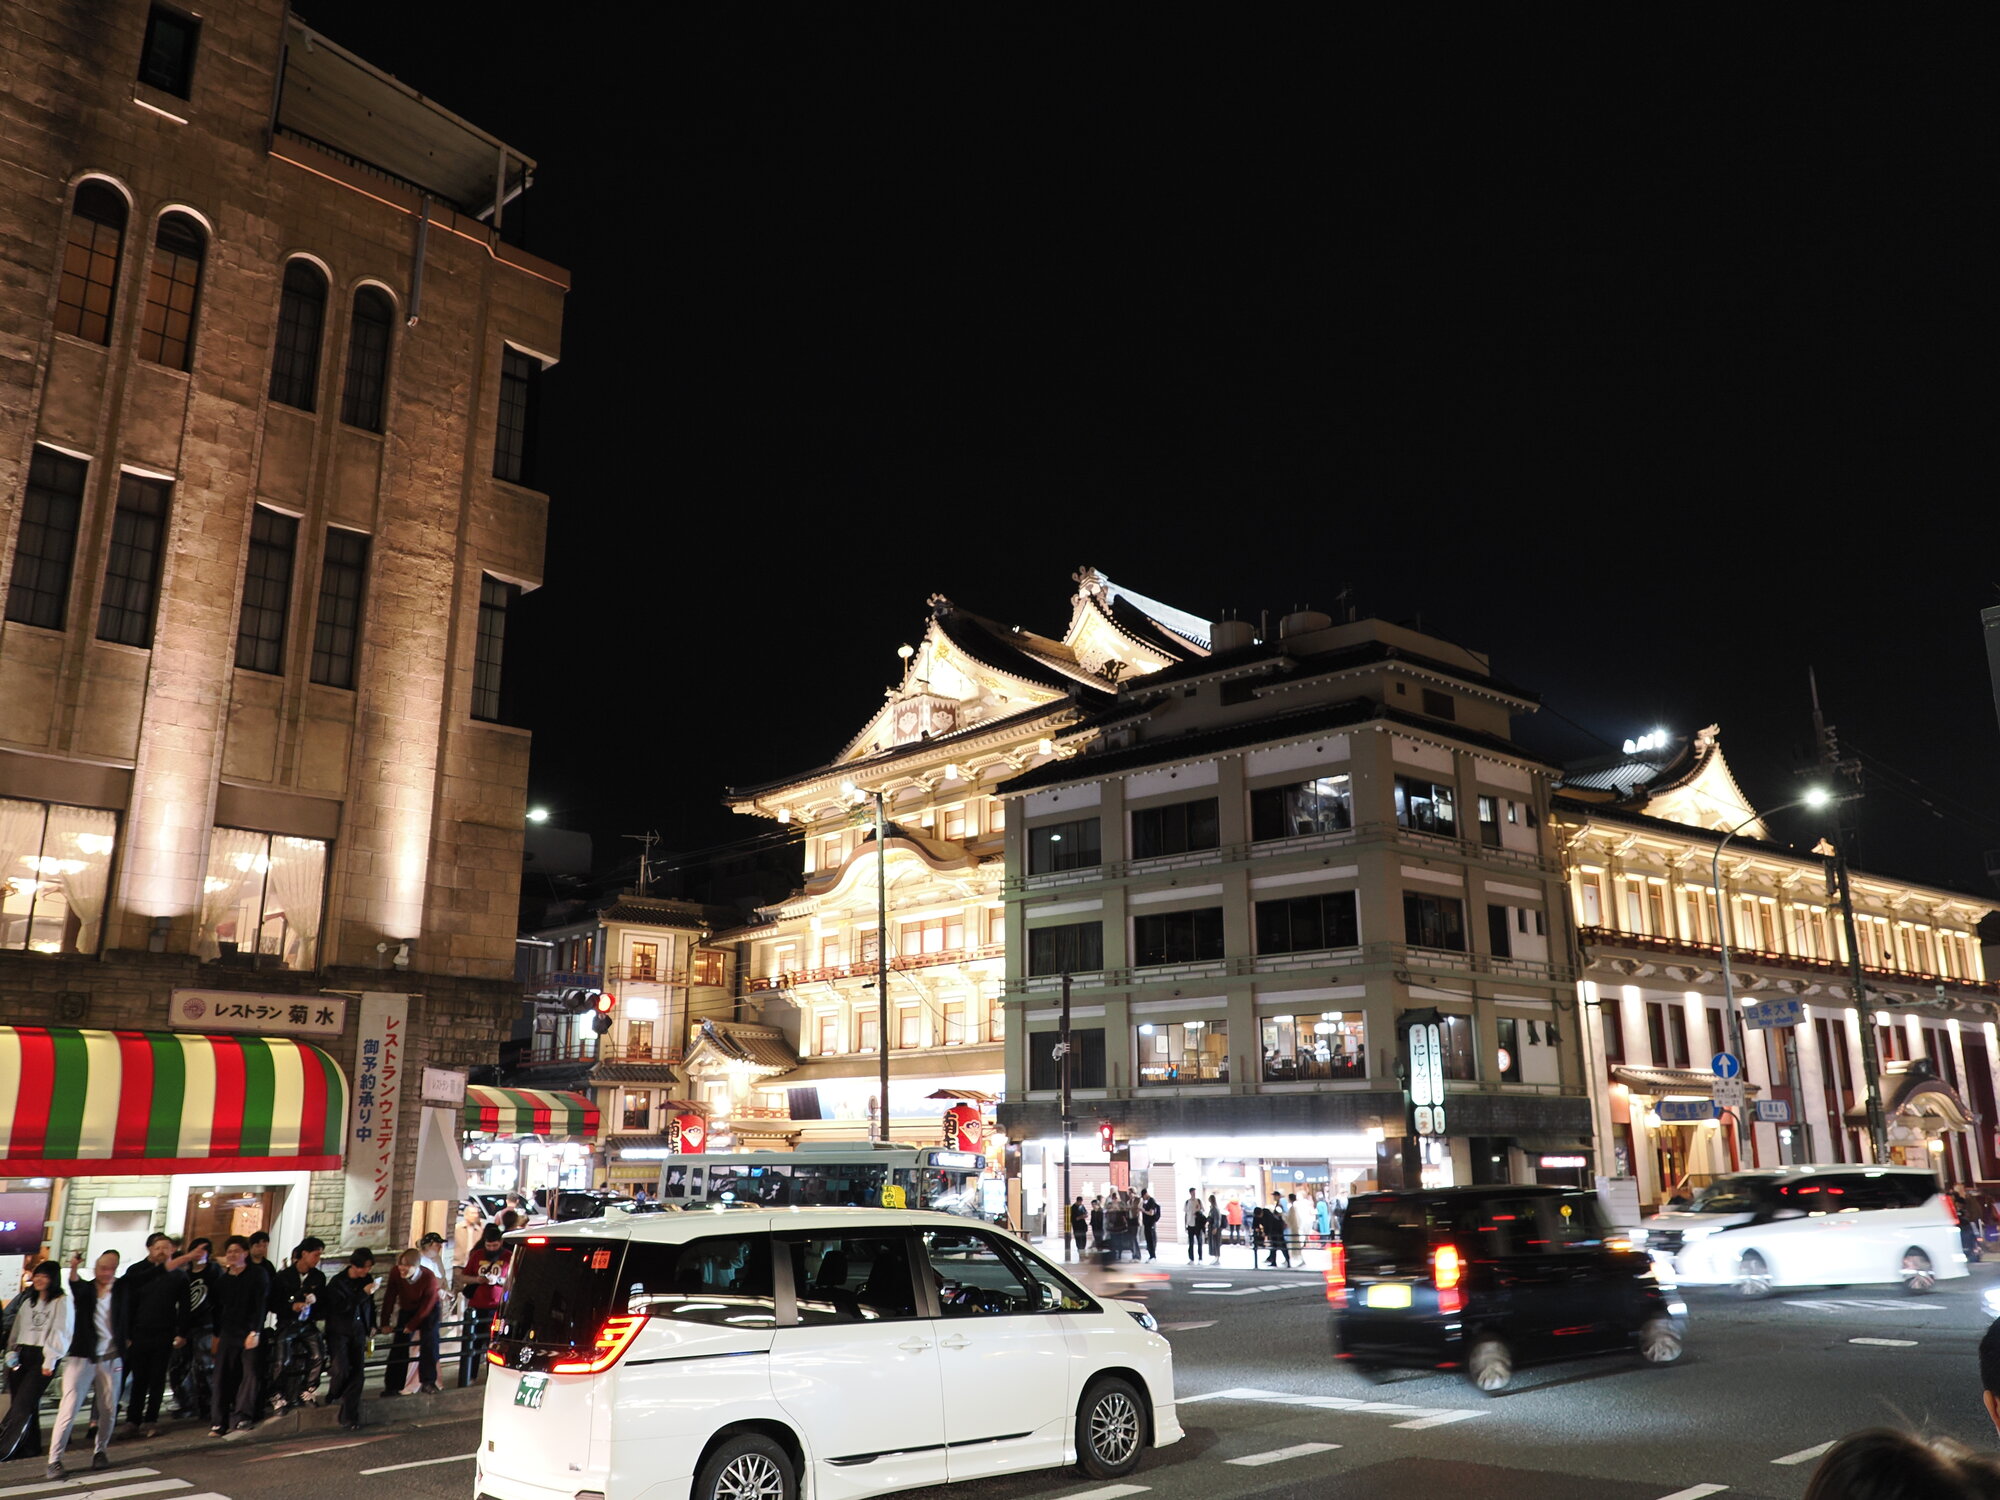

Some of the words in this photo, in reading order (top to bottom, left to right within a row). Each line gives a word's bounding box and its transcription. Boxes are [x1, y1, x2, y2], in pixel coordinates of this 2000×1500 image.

[215, 1003, 282, 1019] レストラン
[288, 1004, 334, 1025] 菊水
[356, 1039, 379, 1142] 御予約承り中
[374, 1015, 400, 1201] レストランウェディング
[350, 1209, 384, 1224] Asahi
